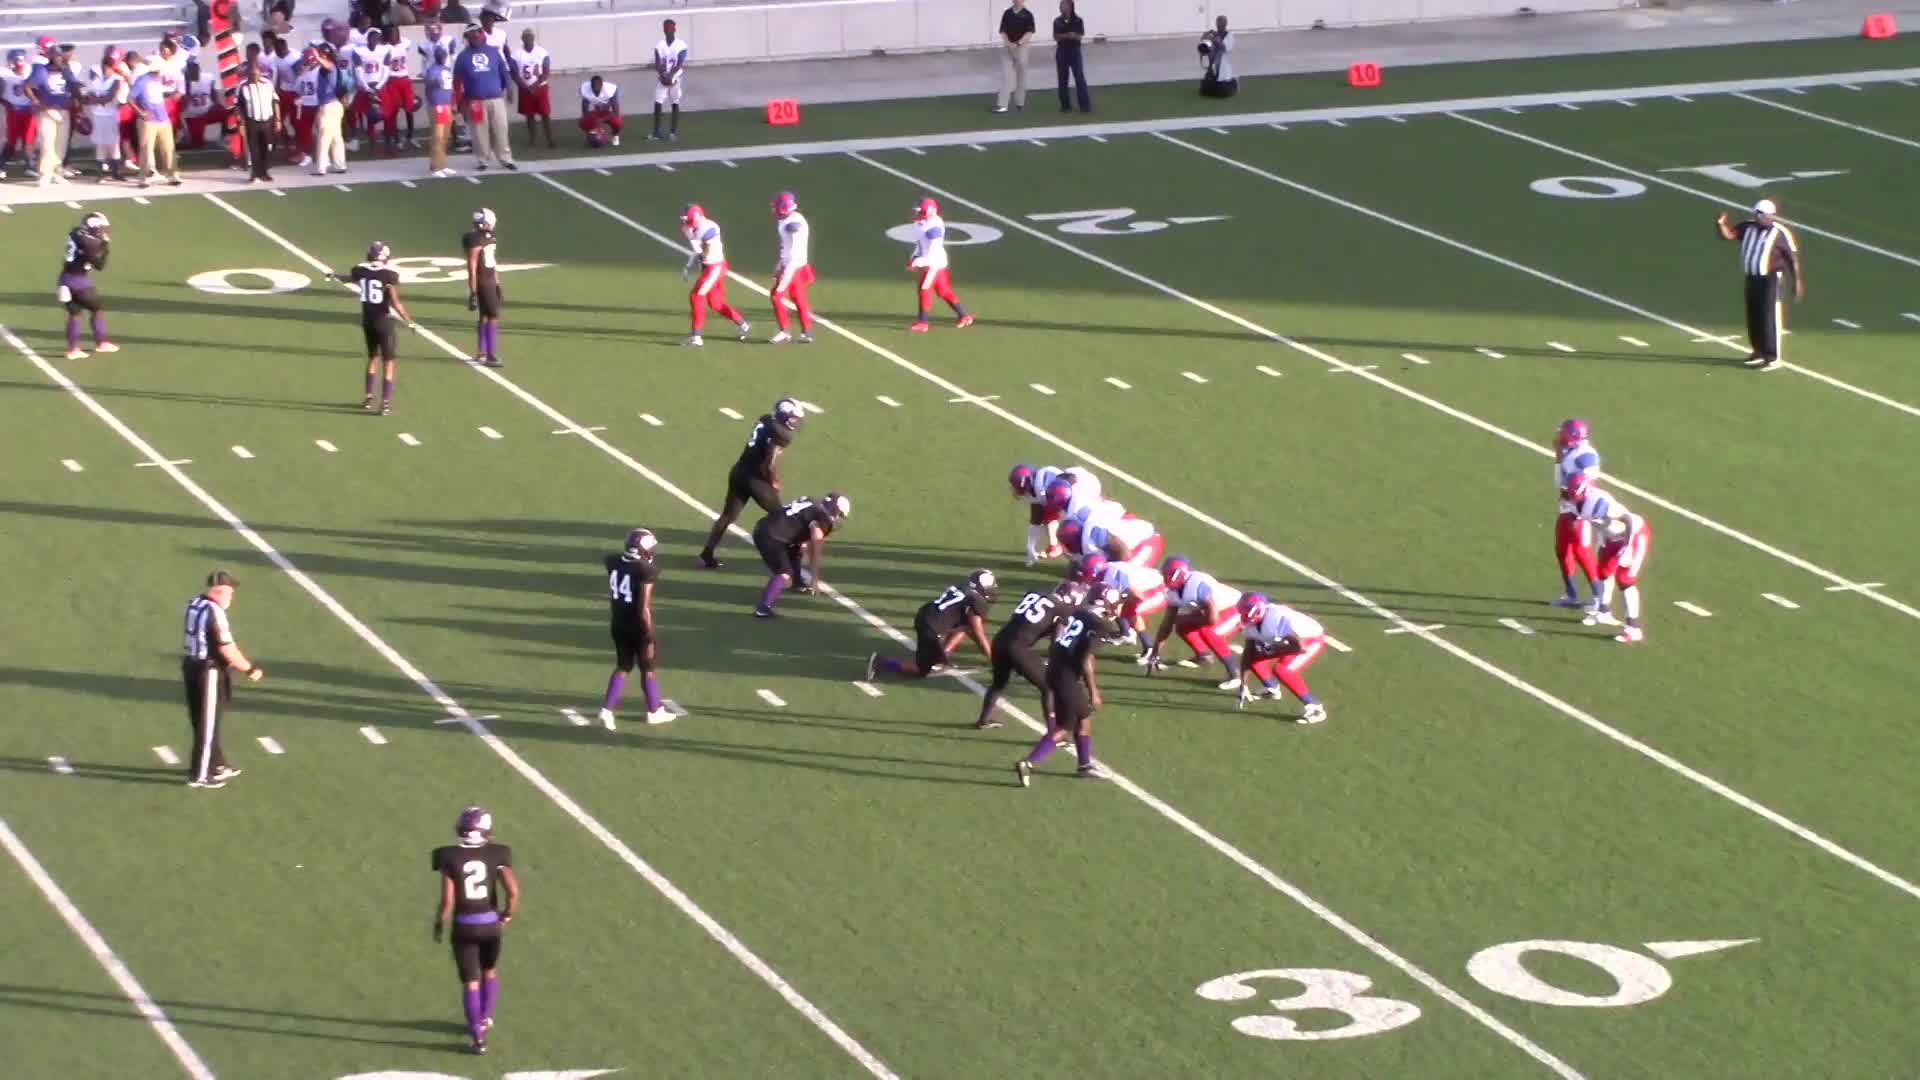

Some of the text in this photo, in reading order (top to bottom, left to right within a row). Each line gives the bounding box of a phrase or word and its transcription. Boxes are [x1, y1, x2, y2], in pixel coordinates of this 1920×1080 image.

[772, 101, 793, 120] 20
[359, 278, 384, 304] 16
[610, 569, 633, 602] 44
[1014, 592, 1055, 624] 85
[463, 860, 489, 900] 2
